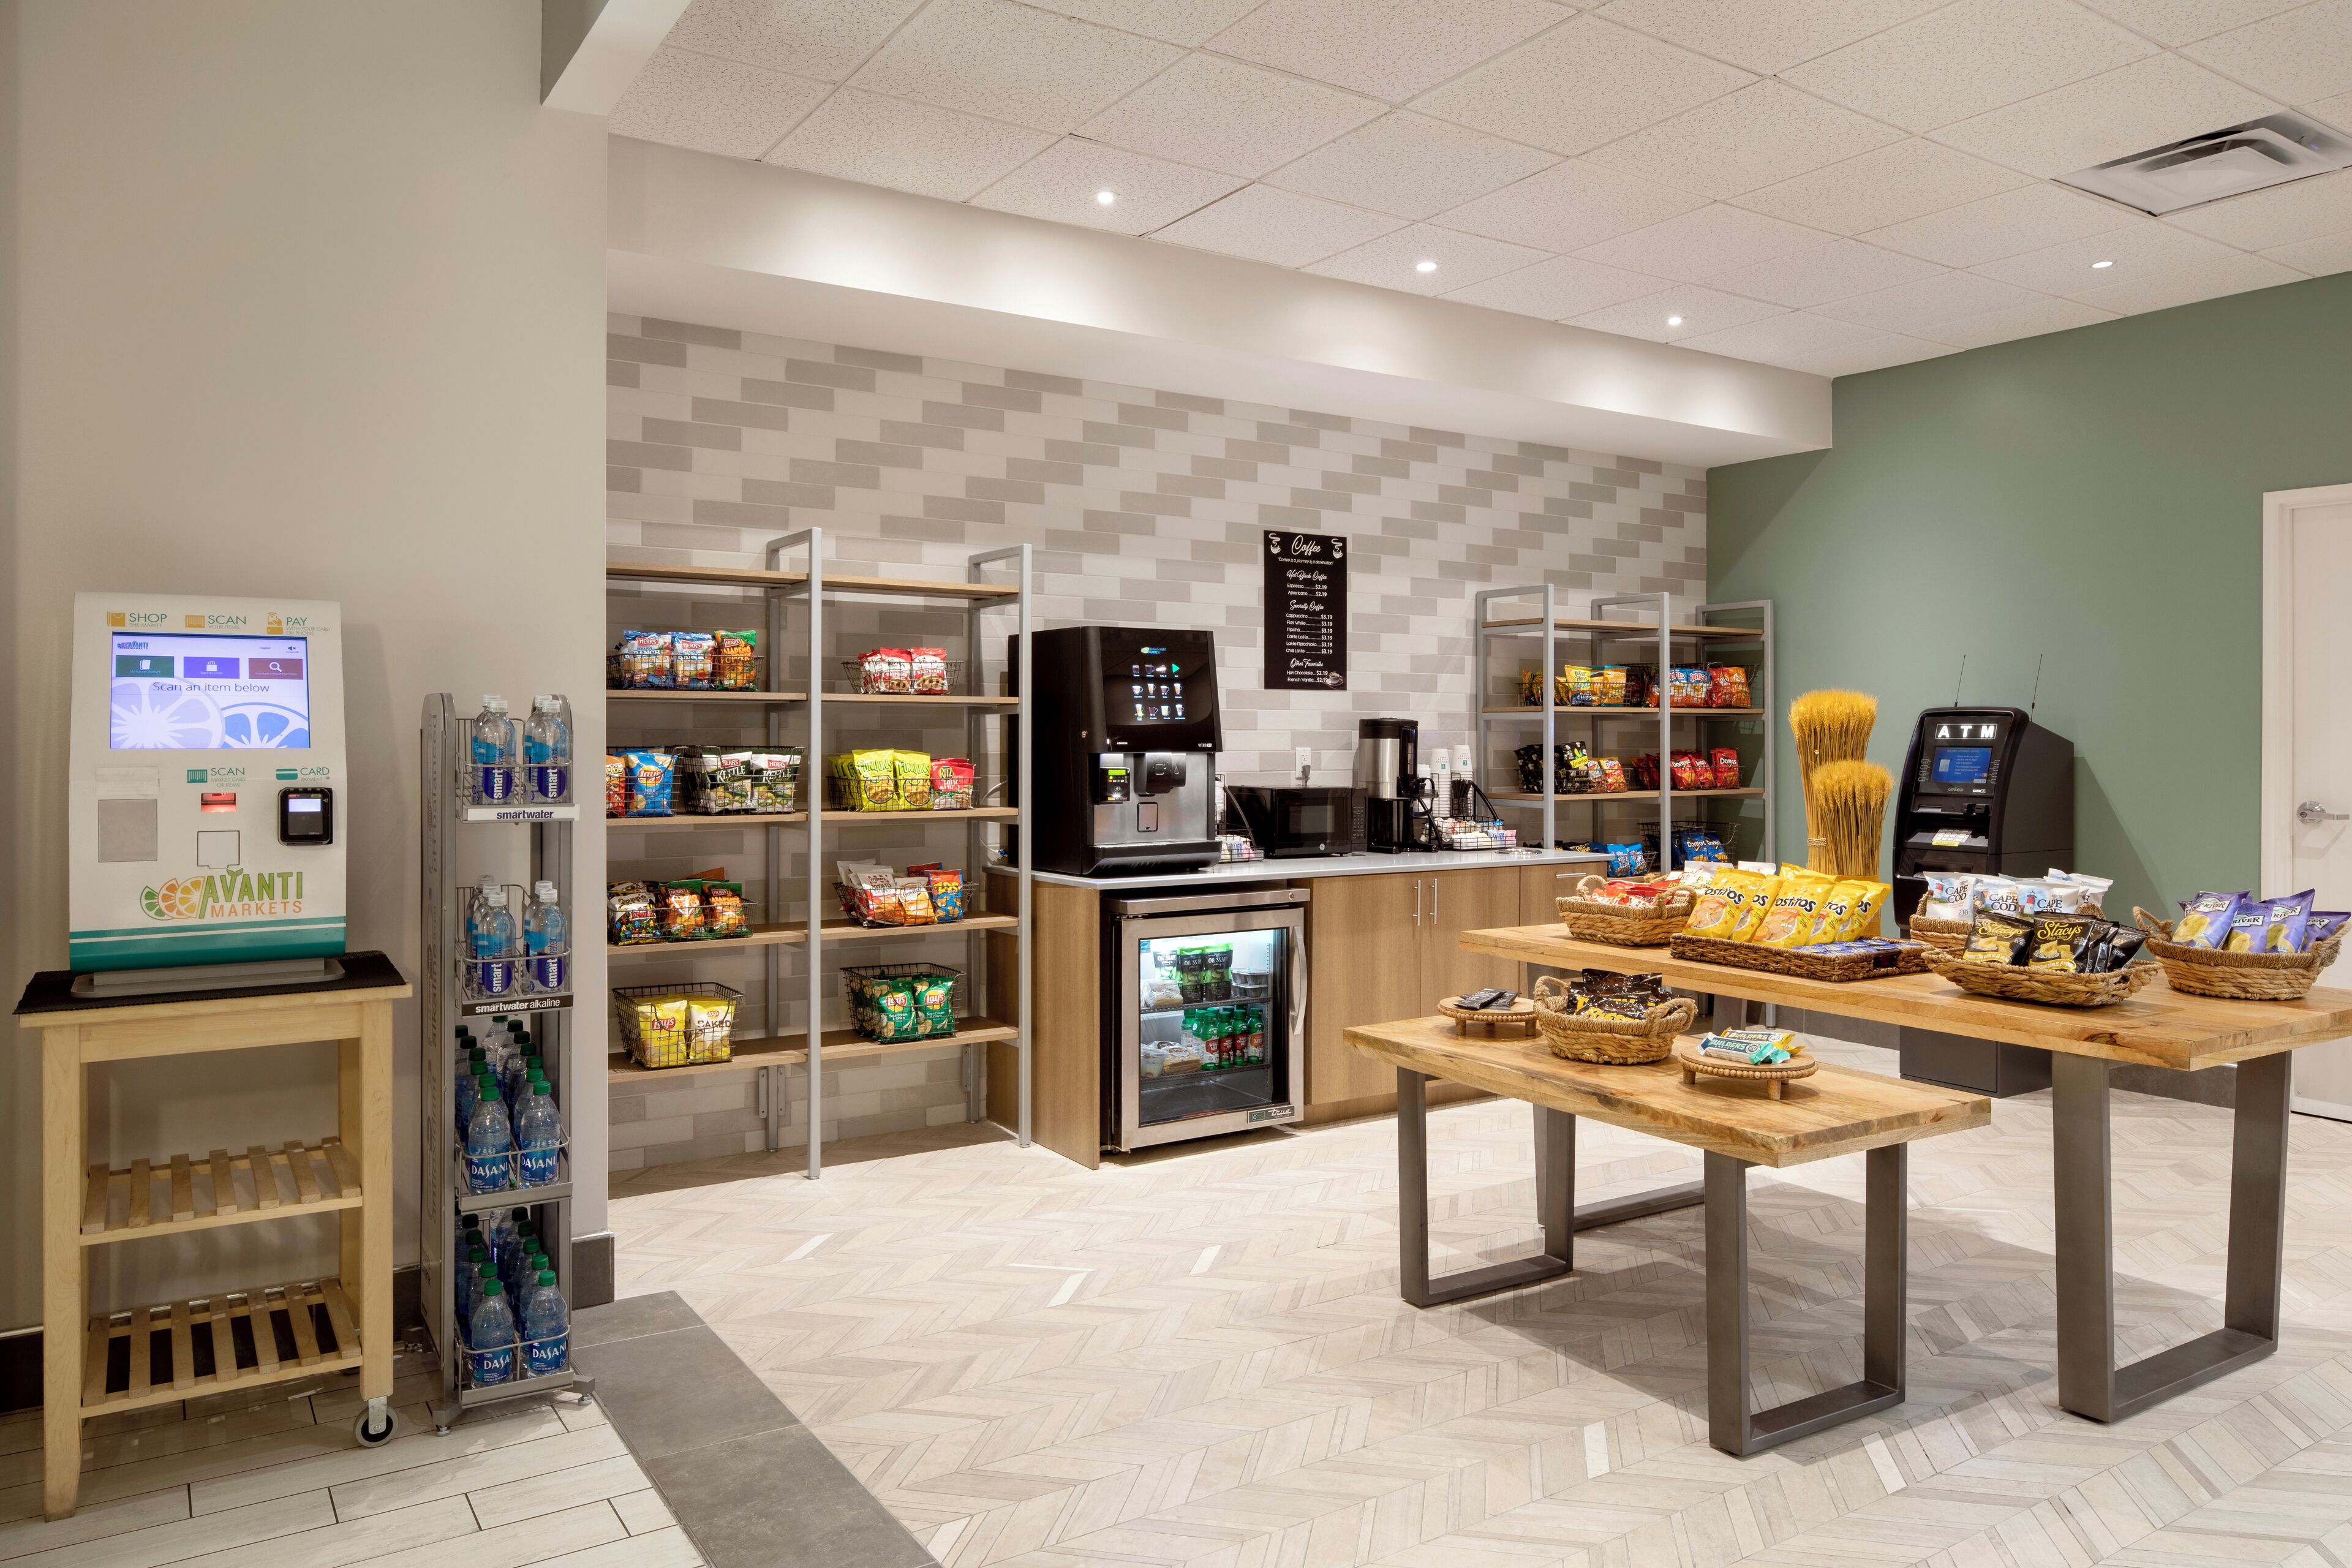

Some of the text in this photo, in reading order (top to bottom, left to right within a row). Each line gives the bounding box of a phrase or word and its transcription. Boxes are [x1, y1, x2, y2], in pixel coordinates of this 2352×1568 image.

[1291, 535, 1321, 556] Coffee
[1286, 569, 1327, 581] Hot Black Coffee
[1289, 600, 1324, 611] Specialty Coffee
[129, 612, 167, 623] SHOP
[208, 615, 246, 625] SCAN
[286, 617, 307, 626] PAY
[1290, 658, 1324, 668] Other Favorites
[1690, 673, 1707, 682] RUFFLES
[153, 682, 182, 692] Scan
[204, 683, 231, 692] item
[235, 683, 270, 692] below
[1937, 725, 1995, 738] ATM
[1671, 758, 1691, 767] Doritos
[211, 767, 246, 776] SCAN
[300, 767, 330, 776] CARD
[715, 765, 746, 783] KETTLE
[763, 768, 792, 784] KETTLE
[939, 767, 953, 778] RITZ
[496, 809, 554, 820] smartwater
[199, 869, 303, 919] AVANTI
[1945, 884, 1969, 895] CAPE
[1947, 893, 1967, 903] COD
[1989, 894, 2018, 904] CAPE
[211, 900, 302, 918] MARKETS
[1991, 902, 2017, 912] COD
[2037, 899, 2063, 909] CAPE
[2273, 908, 2298, 918] RIVR
[1978, 921, 2023, 938] Stacy's
[2037, 921, 2083, 941] Stacy's
[888, 994, 906, 1006] Lay's
[926, 992, 945, 1005] Lay's
[475, 998, 560, 1014] smartwater alkaline
[653, 1016, 676, 1030] Lay's
[1709, 1039, 1747, 1050] BUILDERS
[521, 1156, 556, 1170] DASANI
[472, 1161, 508, 1178] DASANI
[532, 1341, 567, 1360] DASANI
